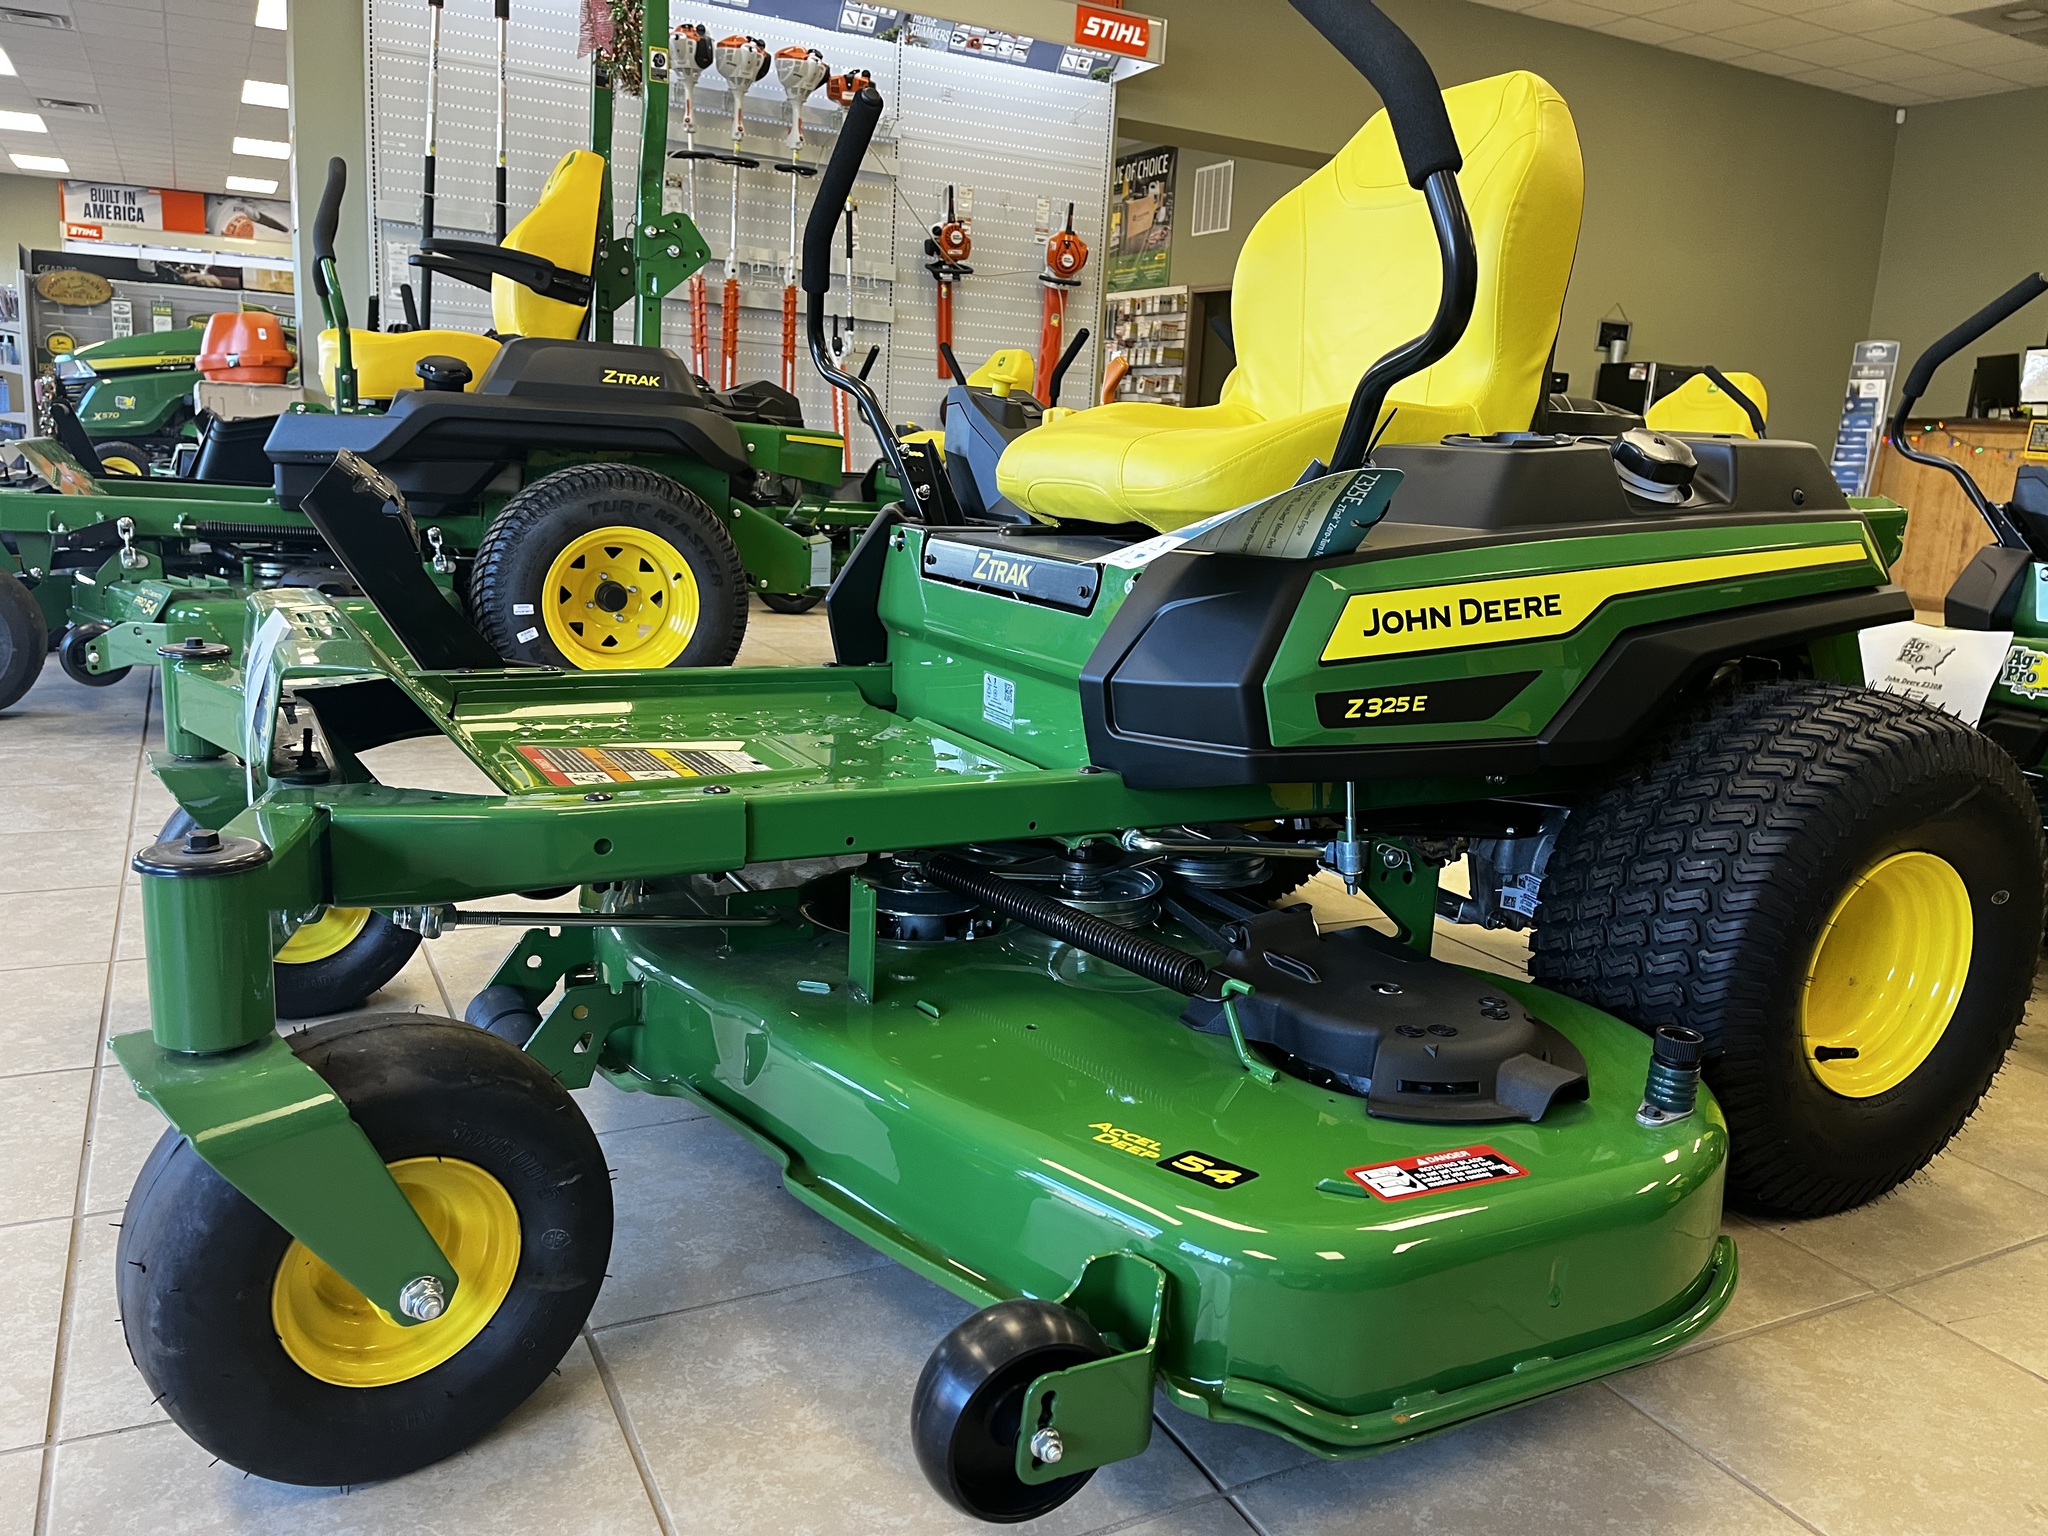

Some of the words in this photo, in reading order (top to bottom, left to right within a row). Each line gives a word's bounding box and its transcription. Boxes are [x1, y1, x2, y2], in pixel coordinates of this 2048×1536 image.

[908, 22, 951, 43] TRIMMERS
[1083, 16, 1146, 46] STIHL
[1125, 161, 1137, 182] OF
[1137, 154, 1170, 180] CHOICE
[91, 187, 119, 204] BUILT
[123, 191, 136, 205] IN
[83, 203, 145, 223] AMERICA
[69, 226, 100, 237] STIHL
[602, 369, 661, 387] ZTRAK
[94, 412, 120, 421] X570
[1341, 474, 1381, 506] Z325E
[587, 500, 653, 516] TURF
[653, 508, 724, 588] MASTER
[974, 552, 1033, 590] ZTRAK
[142, 599, 159, 616] 54
[1363, 605, 1451, 637] JOHN
[1459, 594, 1562, 626] DEERE
[1904, 637, 1930, 651] Ag-
[1898, 649, 1924, 664] Pro
[2008, 650, 2041, 670] Ag-
[1900, 678, 1920, 686] Deere
[2004, 665, 2037, 683] Pro
[1088, 1122, 1162, 1152] ACCEL
[1093, 1133, 1160, 1159] DEEP
[1171, 1155, 1242, 1184] 54
[1418, 1161, 1458, 1173] ROTATING
[1457, 1156, 1486, 1165] BLADE
[1425, 1150, 1471, 1163] DANGER
